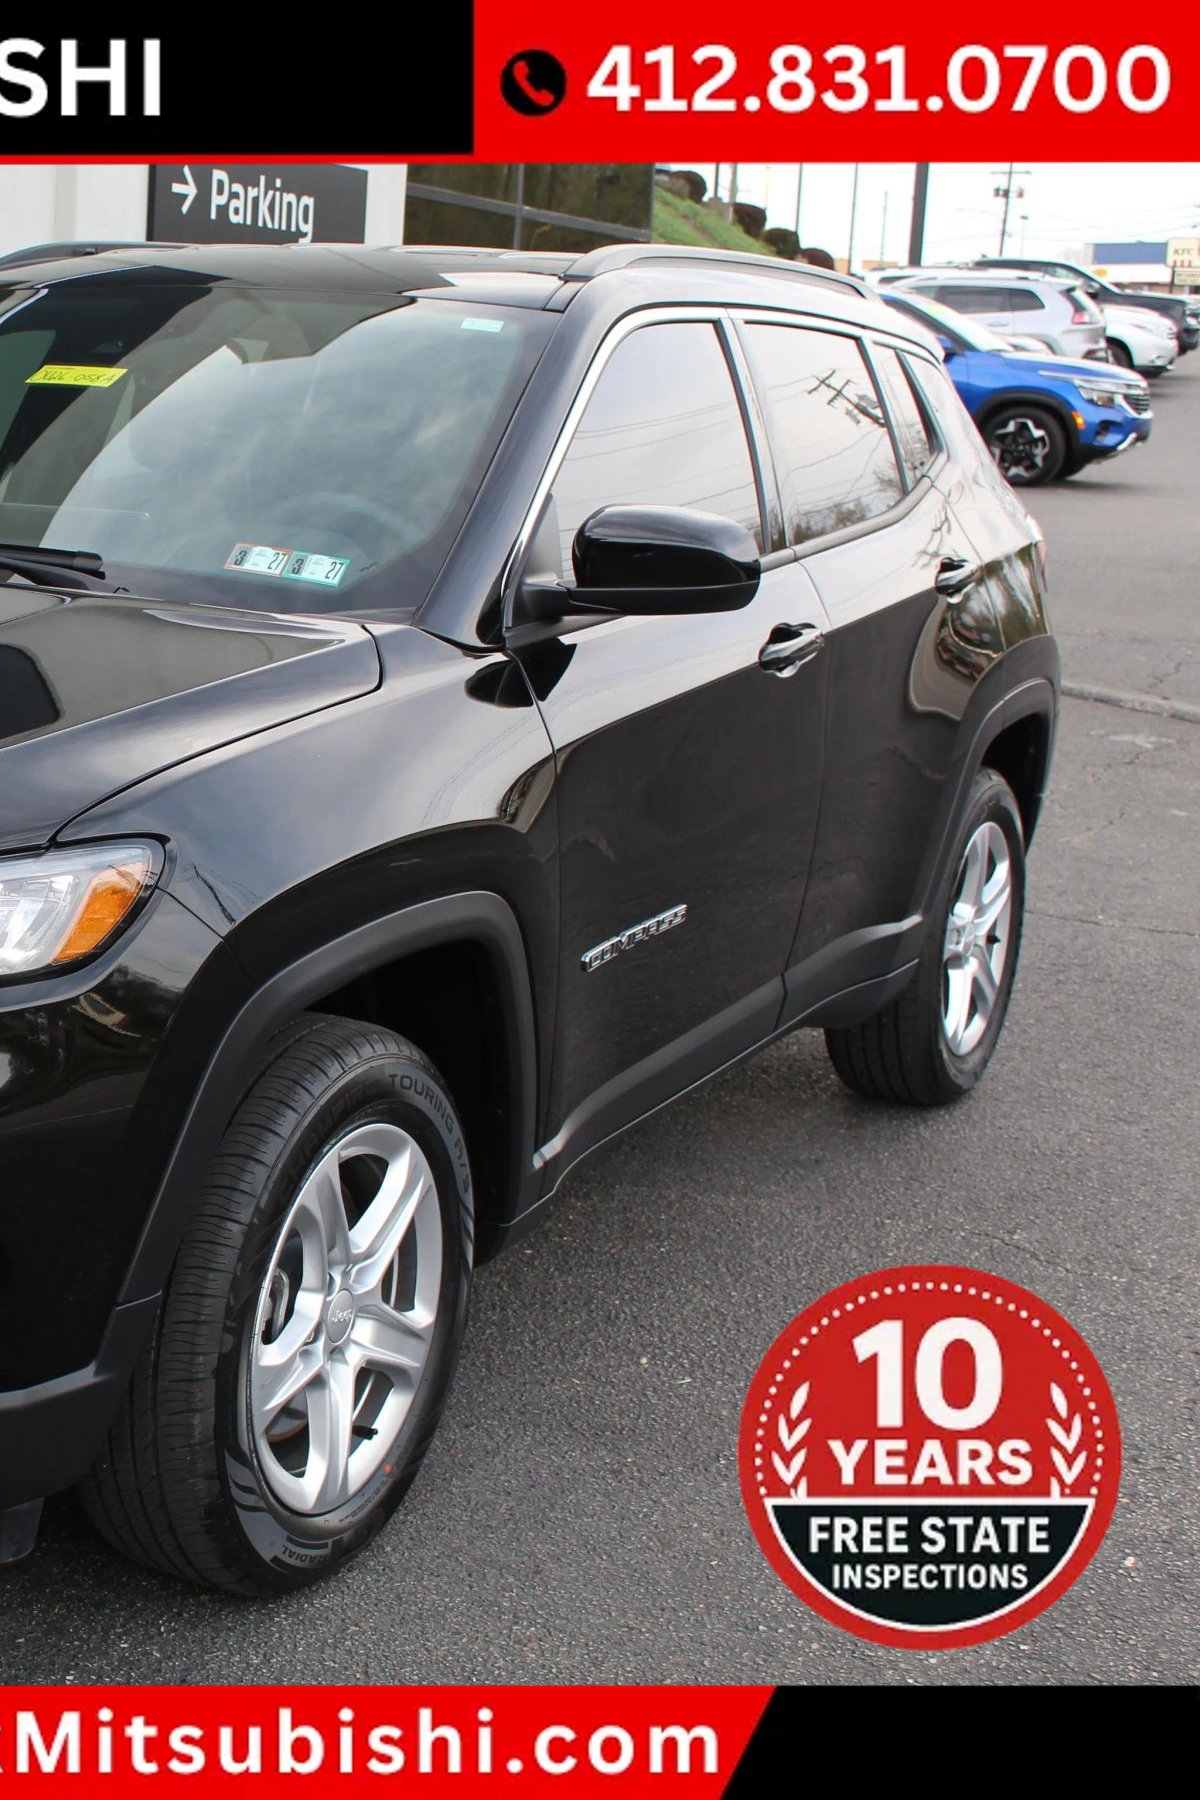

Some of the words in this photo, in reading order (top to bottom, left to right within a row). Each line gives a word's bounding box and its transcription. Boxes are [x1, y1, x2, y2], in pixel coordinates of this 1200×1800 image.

[210, 169, 315, 243] Parking
[233, 550, 247, 566] 3
[267, 552, 287, 571] 27
[291, 558, 305, 575] 3
[324, 561, 344, 580] 27
[388, 1073, 455, 1136] TOURING
